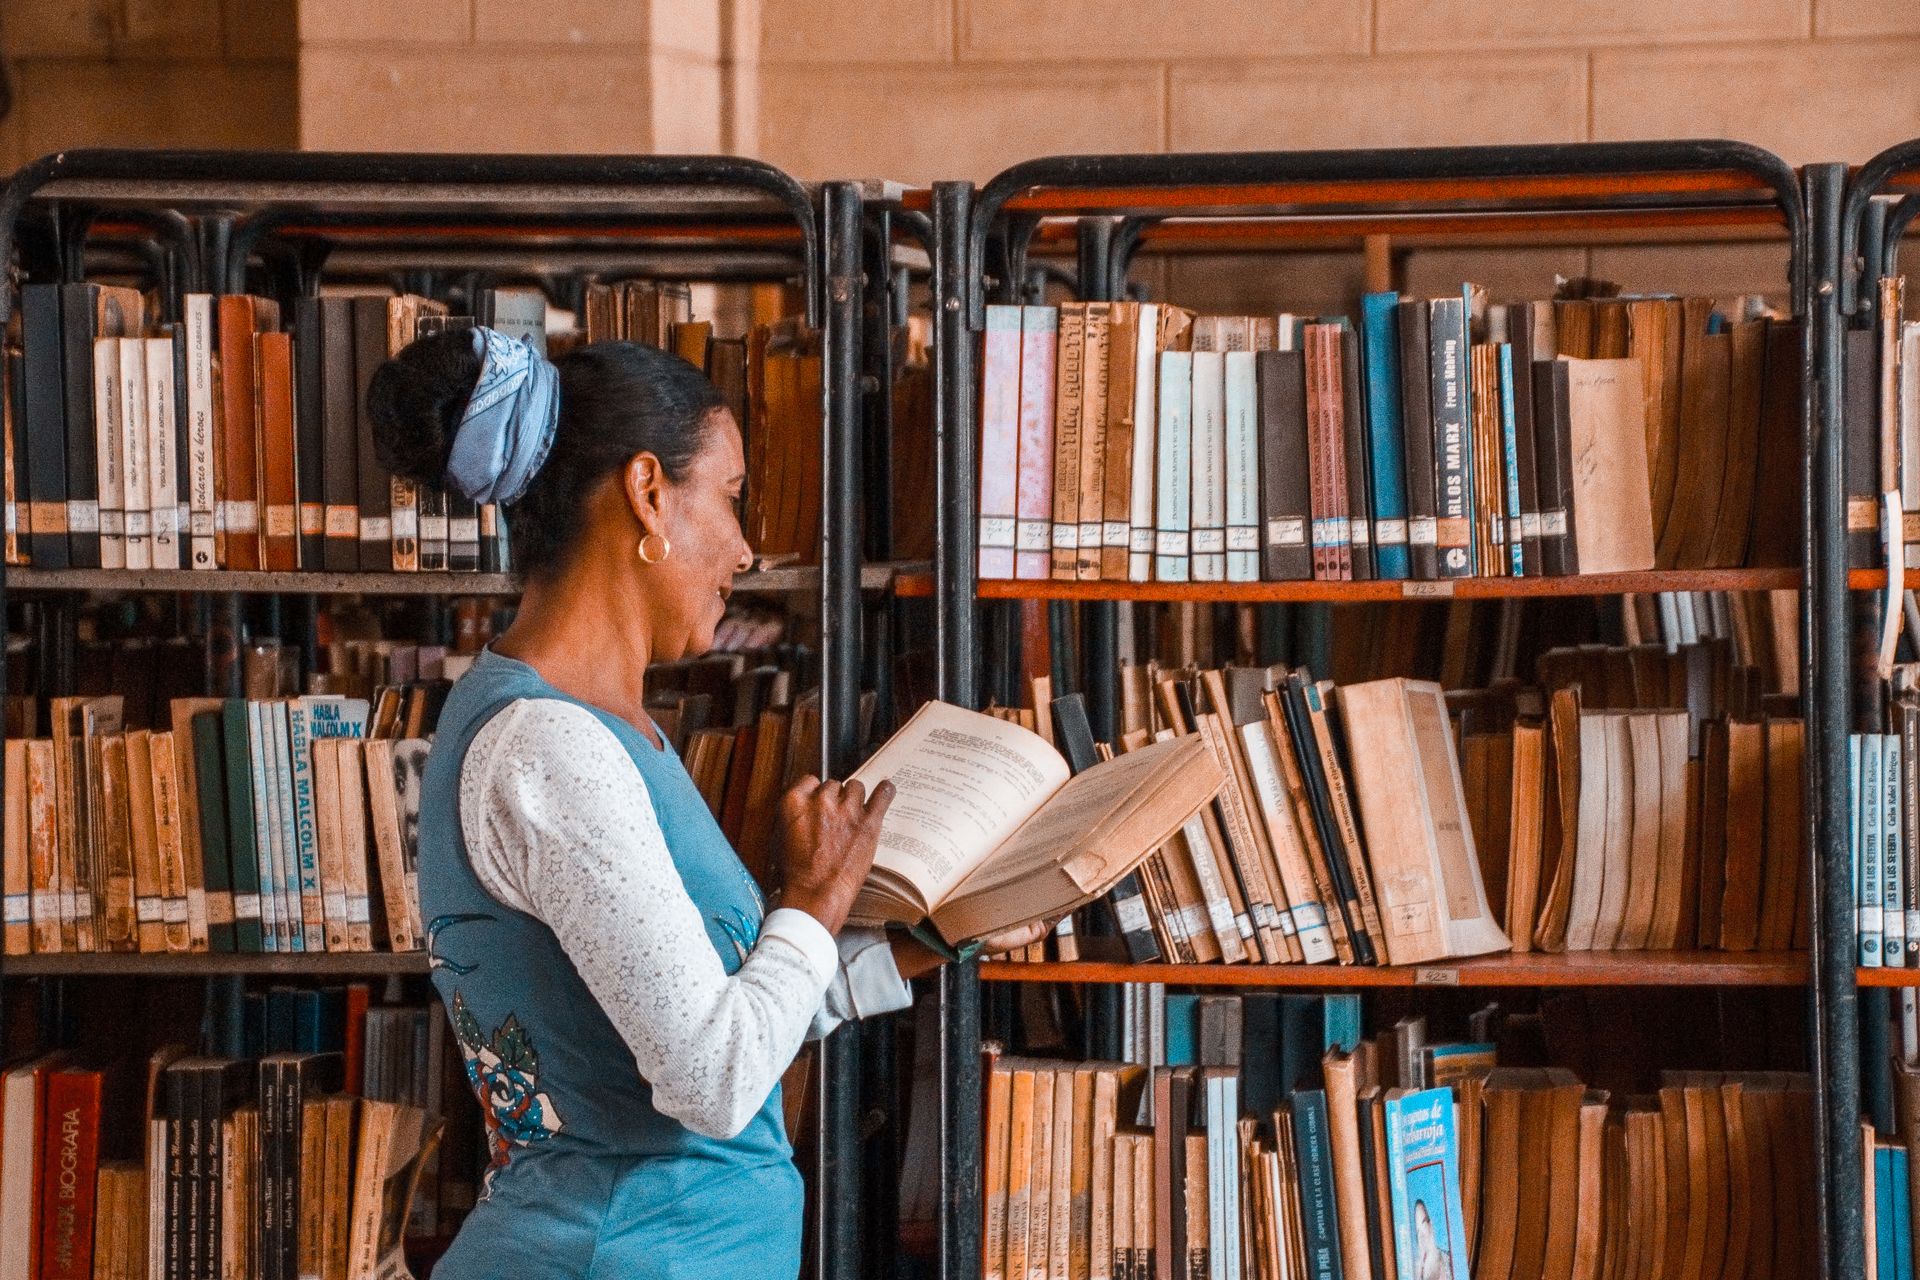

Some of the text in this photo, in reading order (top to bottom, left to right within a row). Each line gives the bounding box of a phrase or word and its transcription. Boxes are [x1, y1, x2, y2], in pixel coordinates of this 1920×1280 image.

[194, 312, 204, 389] GONZALO CABRALES
[1444, 339, 1457, 408] Franz Mehring
[194, 450, 205, 463] de
[1446, 422, 1461, 470] MARX
[194, 466, 206, 511] stolario
[313, 703, 341, 720] HABLA
[310, 721, 361, 737] MALCOLM X
[1267, 778, 1284, 817] OBAMA
[1333, 782, 1342, 792] de
[1868, 785, 1876, 806] Rafael
[1888, 784, 1896, 805] Rafael
[292, 710, 316, 889] HABLA MALCOLM X
[1337, 792, 1350, 826] memoria
[1868, 806, 1876, 827] Carlos
[1888, 807, 1896, 827] Carlos
[1346, 828, 1355, 844] Una
[1887, 833, 1897, 864] SETENTA
[1866, 833, 1876, 890] EN LOS SETENTA
[1887, 865, 1896, 879] LOS
[1887, 880, 1896, 891] EN
[1307, 1106, 1316, 1134] CUBANA
[1431, 1098, 1442, 1119] de
[59, 1108, 80, 1198] BIOGRAFIA
[1310, 1134, 1319, 1162] OBRERA
[1314, 1164, 1322, 1186] CLASE
[265, 1202, 273, 1228] Gladys
[286, 1202, 294, 1228] Gladys
[1011, 1232, 1020, 1256] ENTRE
[1014, 1260, 1022, 1280] NK
[1317, 1248, 1330, 1270] PEÑA
